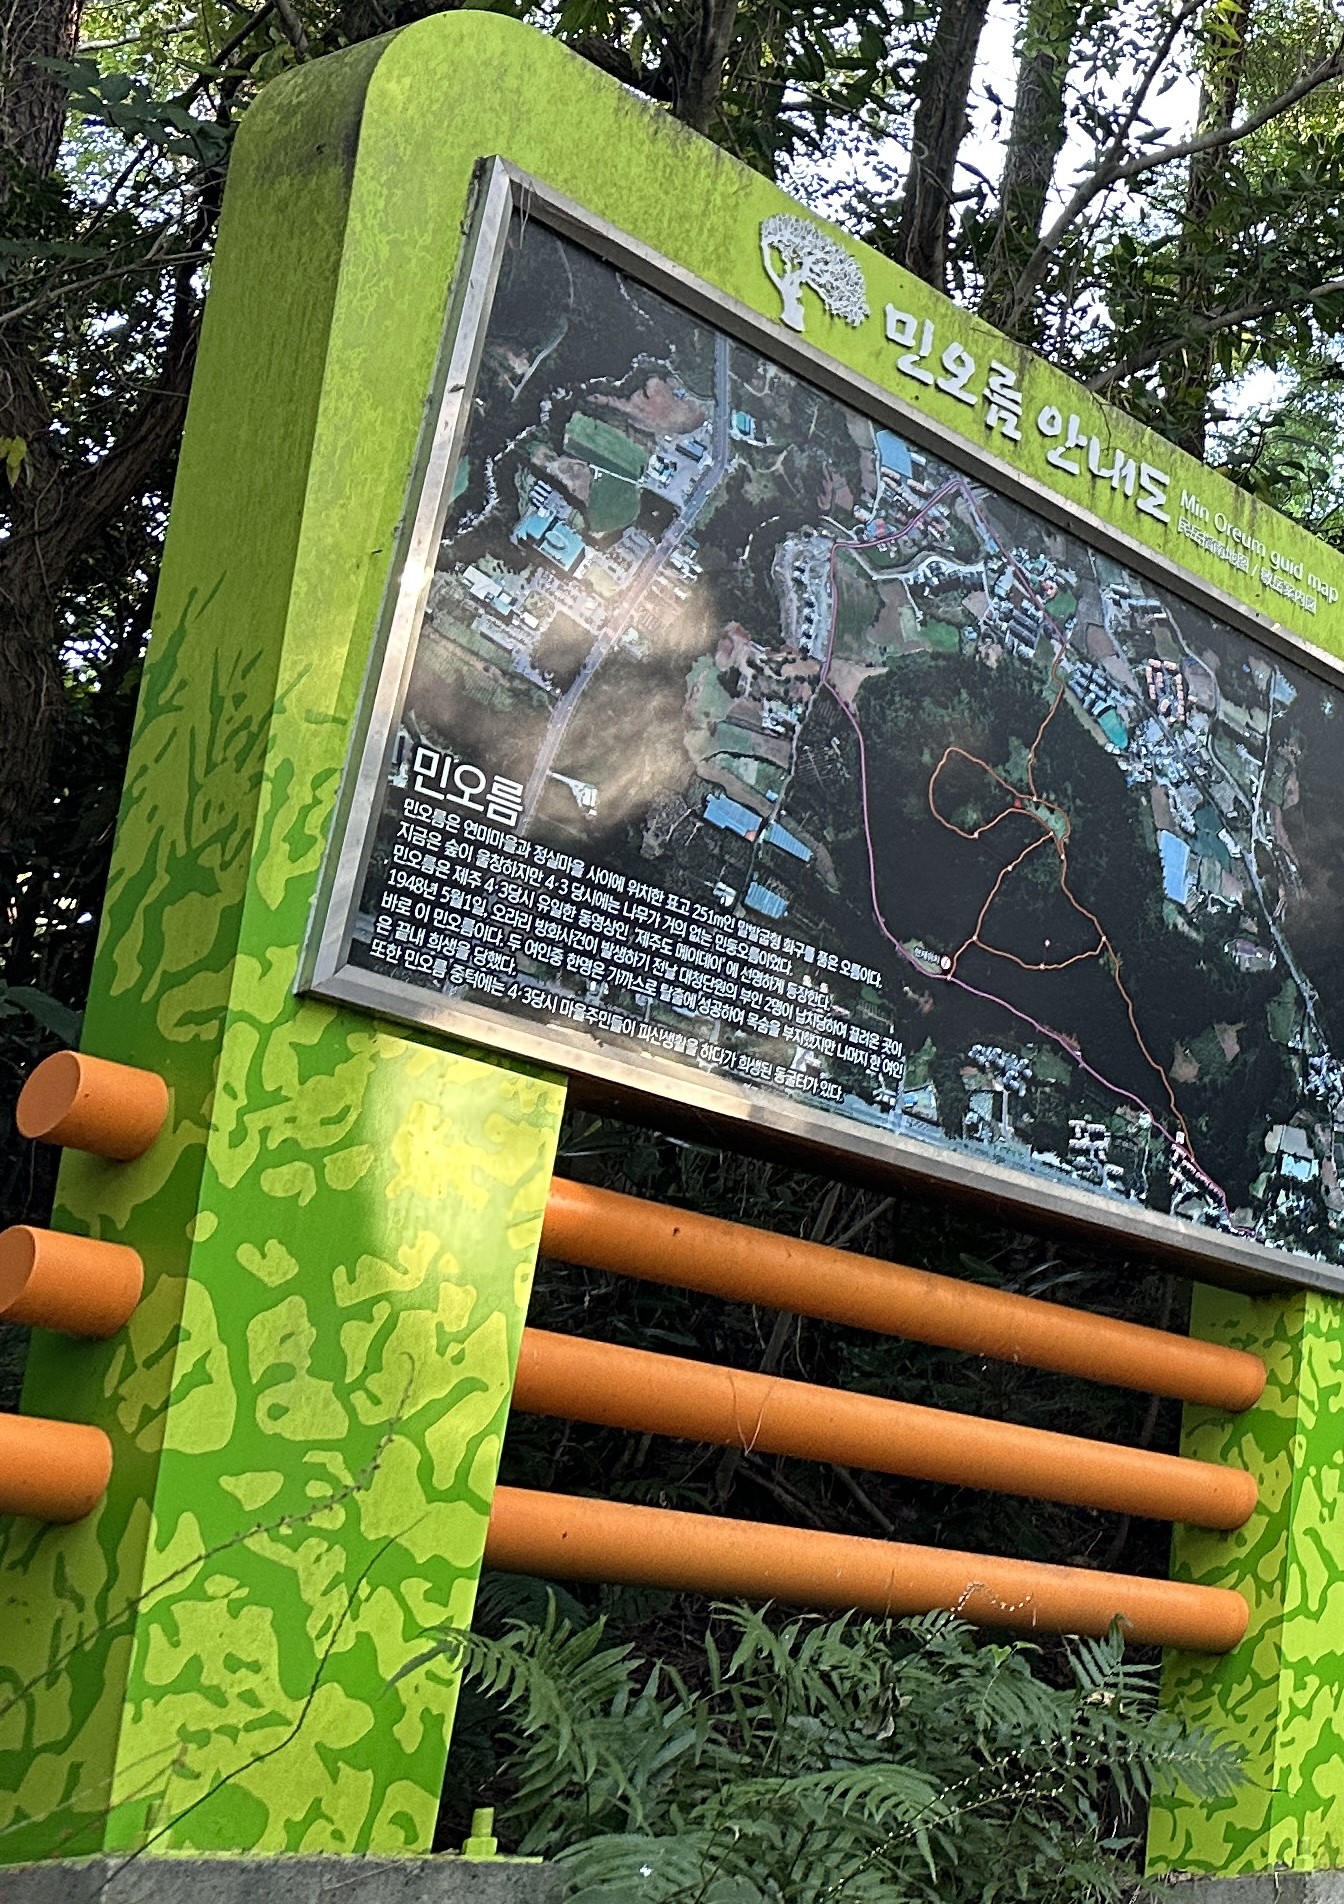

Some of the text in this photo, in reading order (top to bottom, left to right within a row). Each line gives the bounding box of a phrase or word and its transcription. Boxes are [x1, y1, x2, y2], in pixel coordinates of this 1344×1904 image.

[883, 302, 1172, 525] 민오름 안내도
[1179, 488, 1339, 604] Min Oreum guid map
[413, 746, 524, 827] 민오름
[375, 914, 518, 977] 은 끝내 희생을 당했다.
[386, 867, 902, 1059] 1948년 5월1일, 오라리 방화사건이 발생하기 전날 대청단원의 부인 2명이 납치당하여 끌려온 곳이
[391, 843, 451, 880] 민오름은
[451, 864, 482, 891] 제주
[536, 894, 576, 923] 유일한
[577, 908, 629, 941] 동영상인
[739, 965, 784, 995] 선명하게
[786, 981, 832, 1011] 등장한다.
[396, 821, 442, 852] 지금은
[443, 837, 473, 863] 숲이
[474, 849, 543, 888] 울창하지만
[569, 882, 621, 916] 당시에는
[622, 901, 661, 930] 나무가
[661, 915, 687, 939] 거의
[687, 924, 713, 948] 없는
[401, 797, 461, 834] 민오름은
[461, 819, 532, 860] 연미마을과
[531, 844, 585, 879] 정실마을
[586, 865, 625, 894] 사이에
[626, 879, 665, 909] 위치한
[664, 893, 690, 918] 표고
[691, 903, 735, 934] 251m인
[781, 937, 815, 963] 화구를
[816, 949, 839, 972] 품은
[839, 958, 883, 988] 오름이다.
[369, 938, 402, 965] 또한
[402, 949, 447, 979] 민오름
[449, 963, 506, 997] 중턱에는
[559, 998, 636, 1037] 마을주민들이
[699, 1042, 736, 1069] 하다가
[737, 1054, 773, 1080] 희생된
[773, 1065, 817, 1094] 동굴터가
[819, 1079, 844, 1102] 있다.
[380, 891, 904, 1079] 바로 이 민오름이다. 두 여인중 한명은 가까스로 탈출에 성공하여 목숨을 부지했지만 나머지 한 여인
